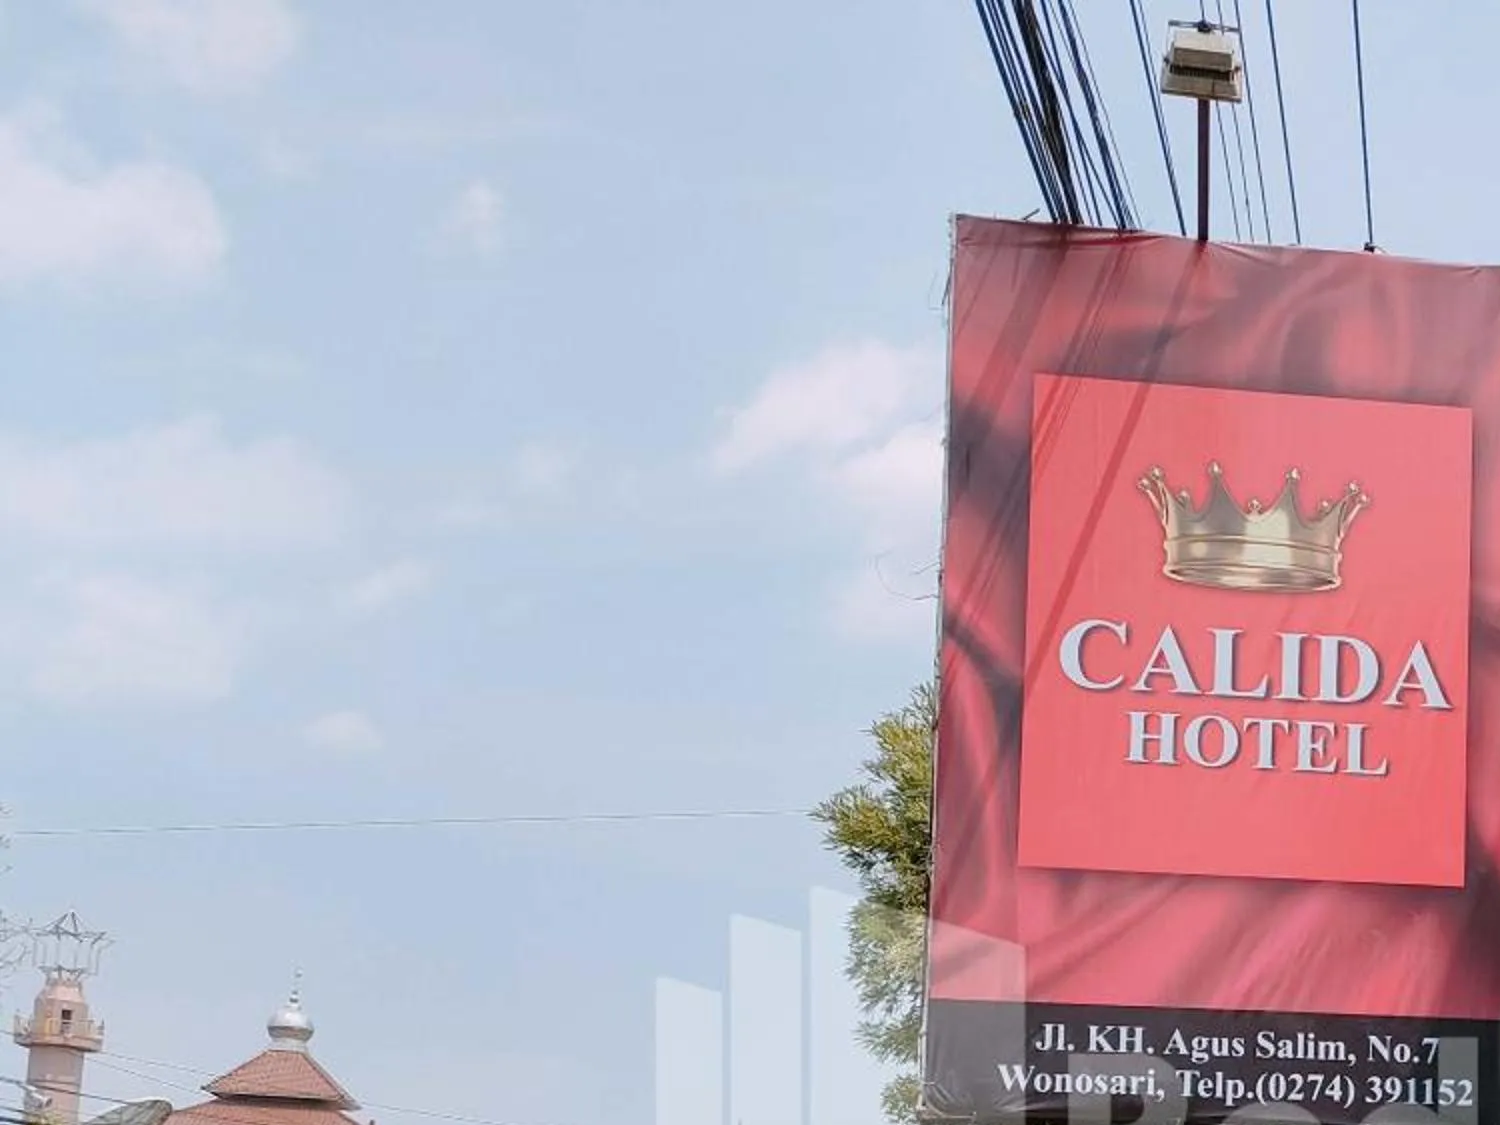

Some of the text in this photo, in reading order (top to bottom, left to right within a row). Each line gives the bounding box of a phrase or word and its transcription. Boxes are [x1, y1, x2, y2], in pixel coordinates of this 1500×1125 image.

[1058, 619, 1454, 709] CALIDA
[1124, 711, 1390, 776] HOTEL
[1035, 1023, 1440, 1066] Jl. KH. Agus Salim, No.7
[998, 1064, 1165, 1102] Wonosari,
[1365, 1077, 1473, 1106] 391152
